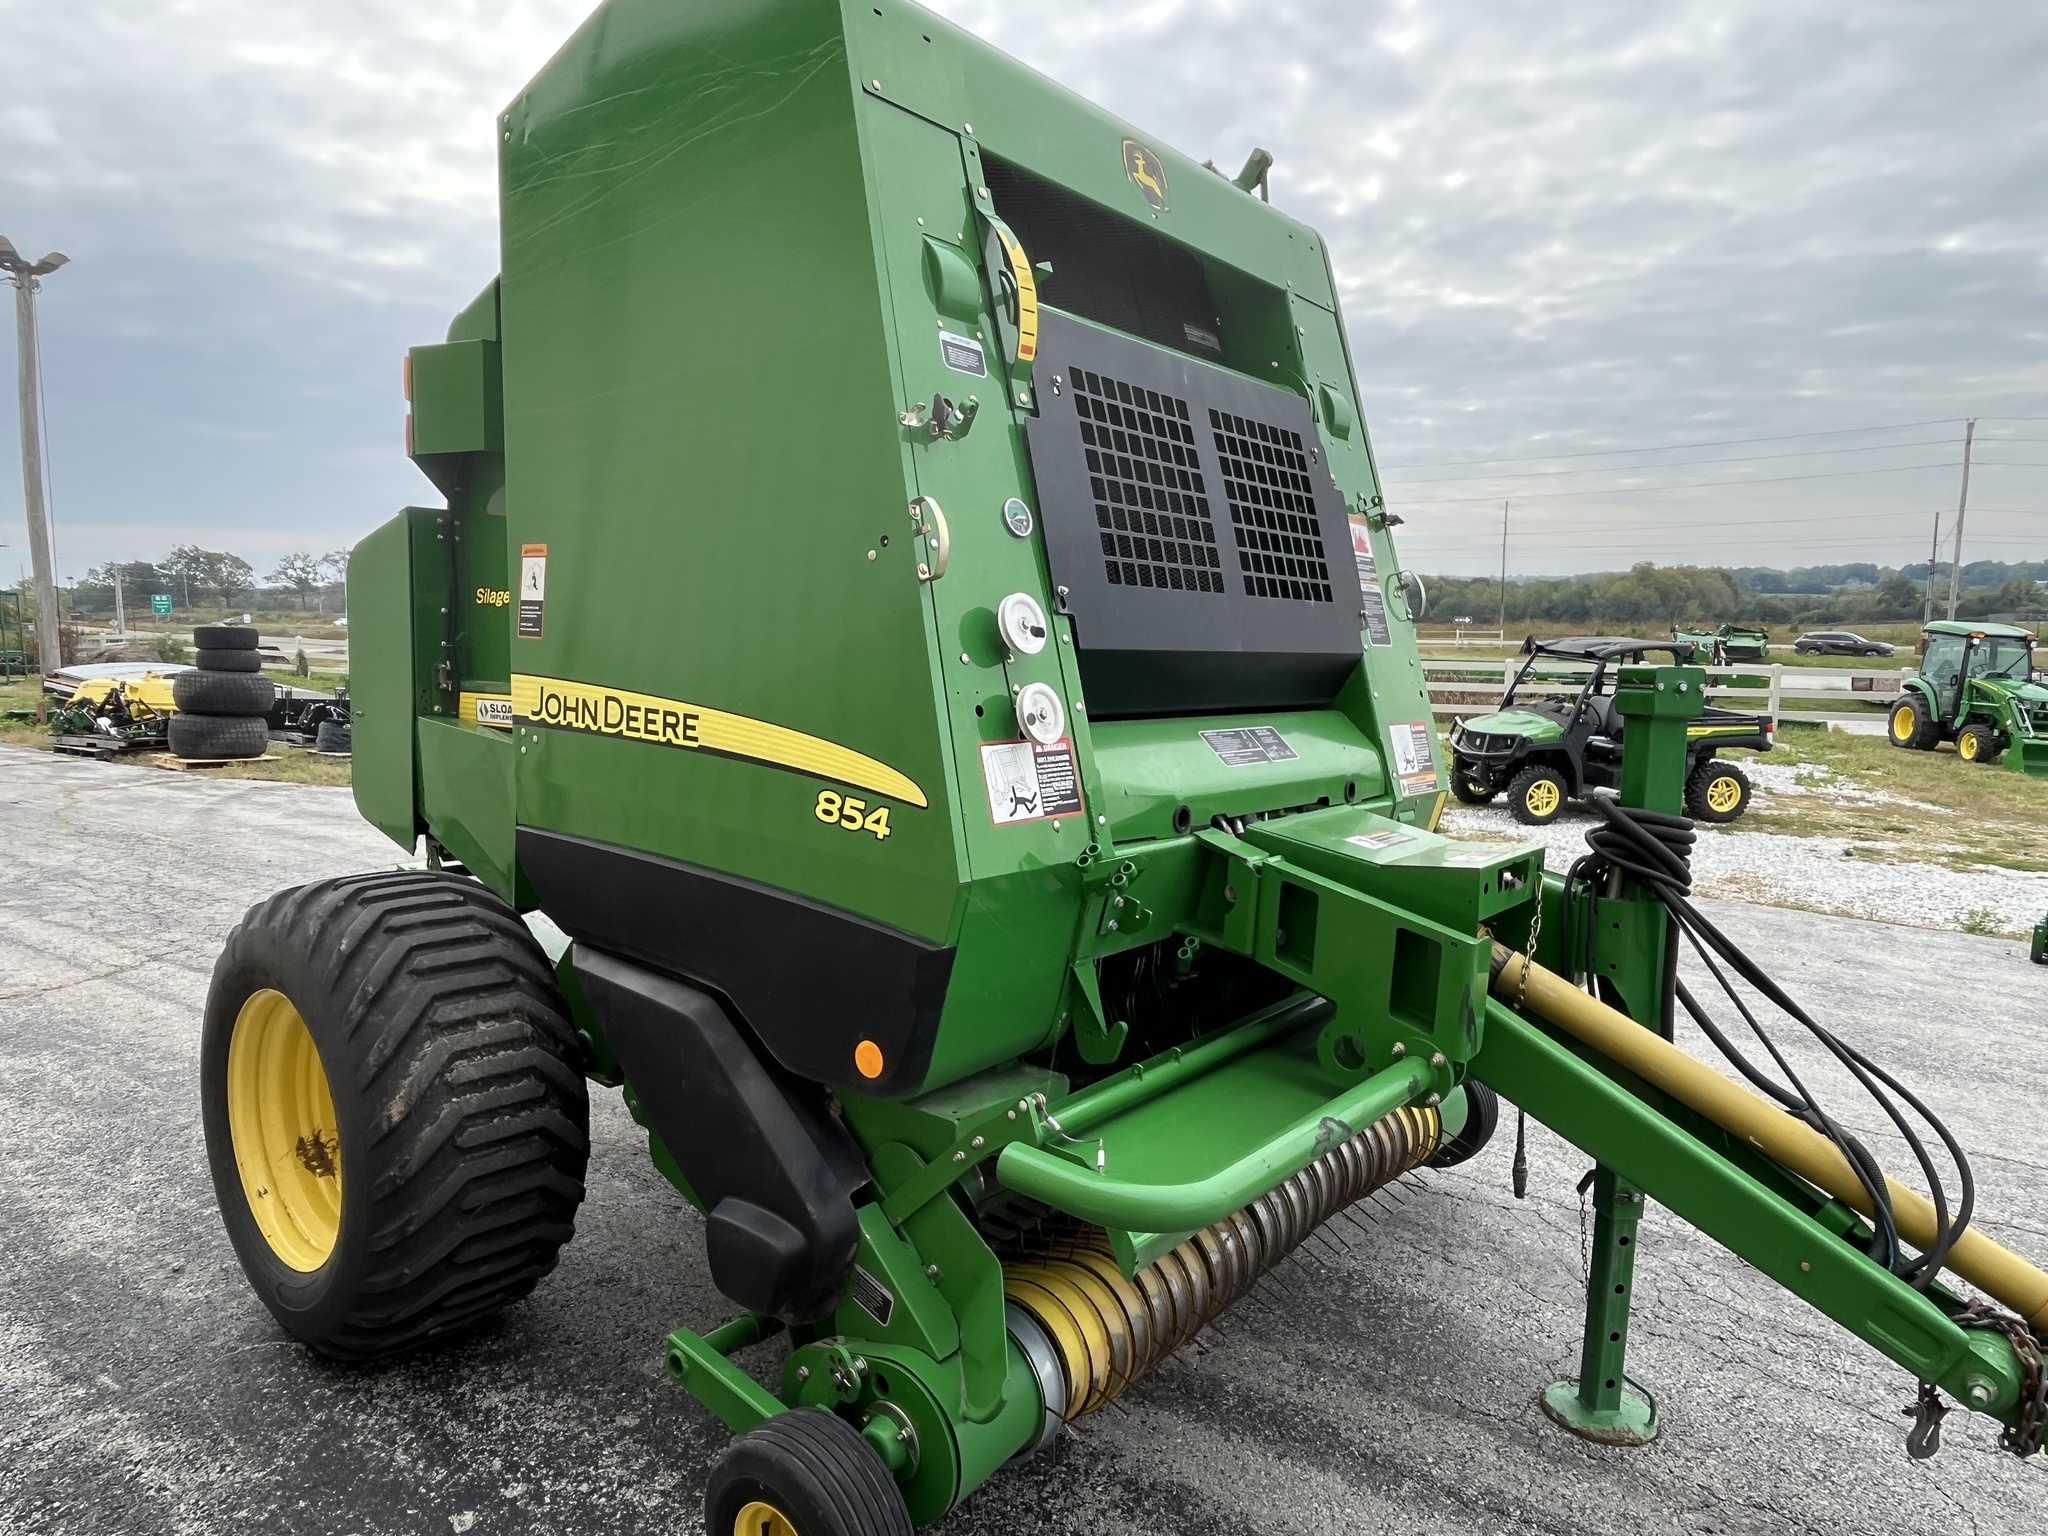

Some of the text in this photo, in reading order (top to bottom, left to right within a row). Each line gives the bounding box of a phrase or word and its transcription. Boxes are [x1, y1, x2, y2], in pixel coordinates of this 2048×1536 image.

[476, 587, 510, 607] Silage
[531, 686, 700, 743] JOHN DEERE
[814, 789, 892, 840] 854
